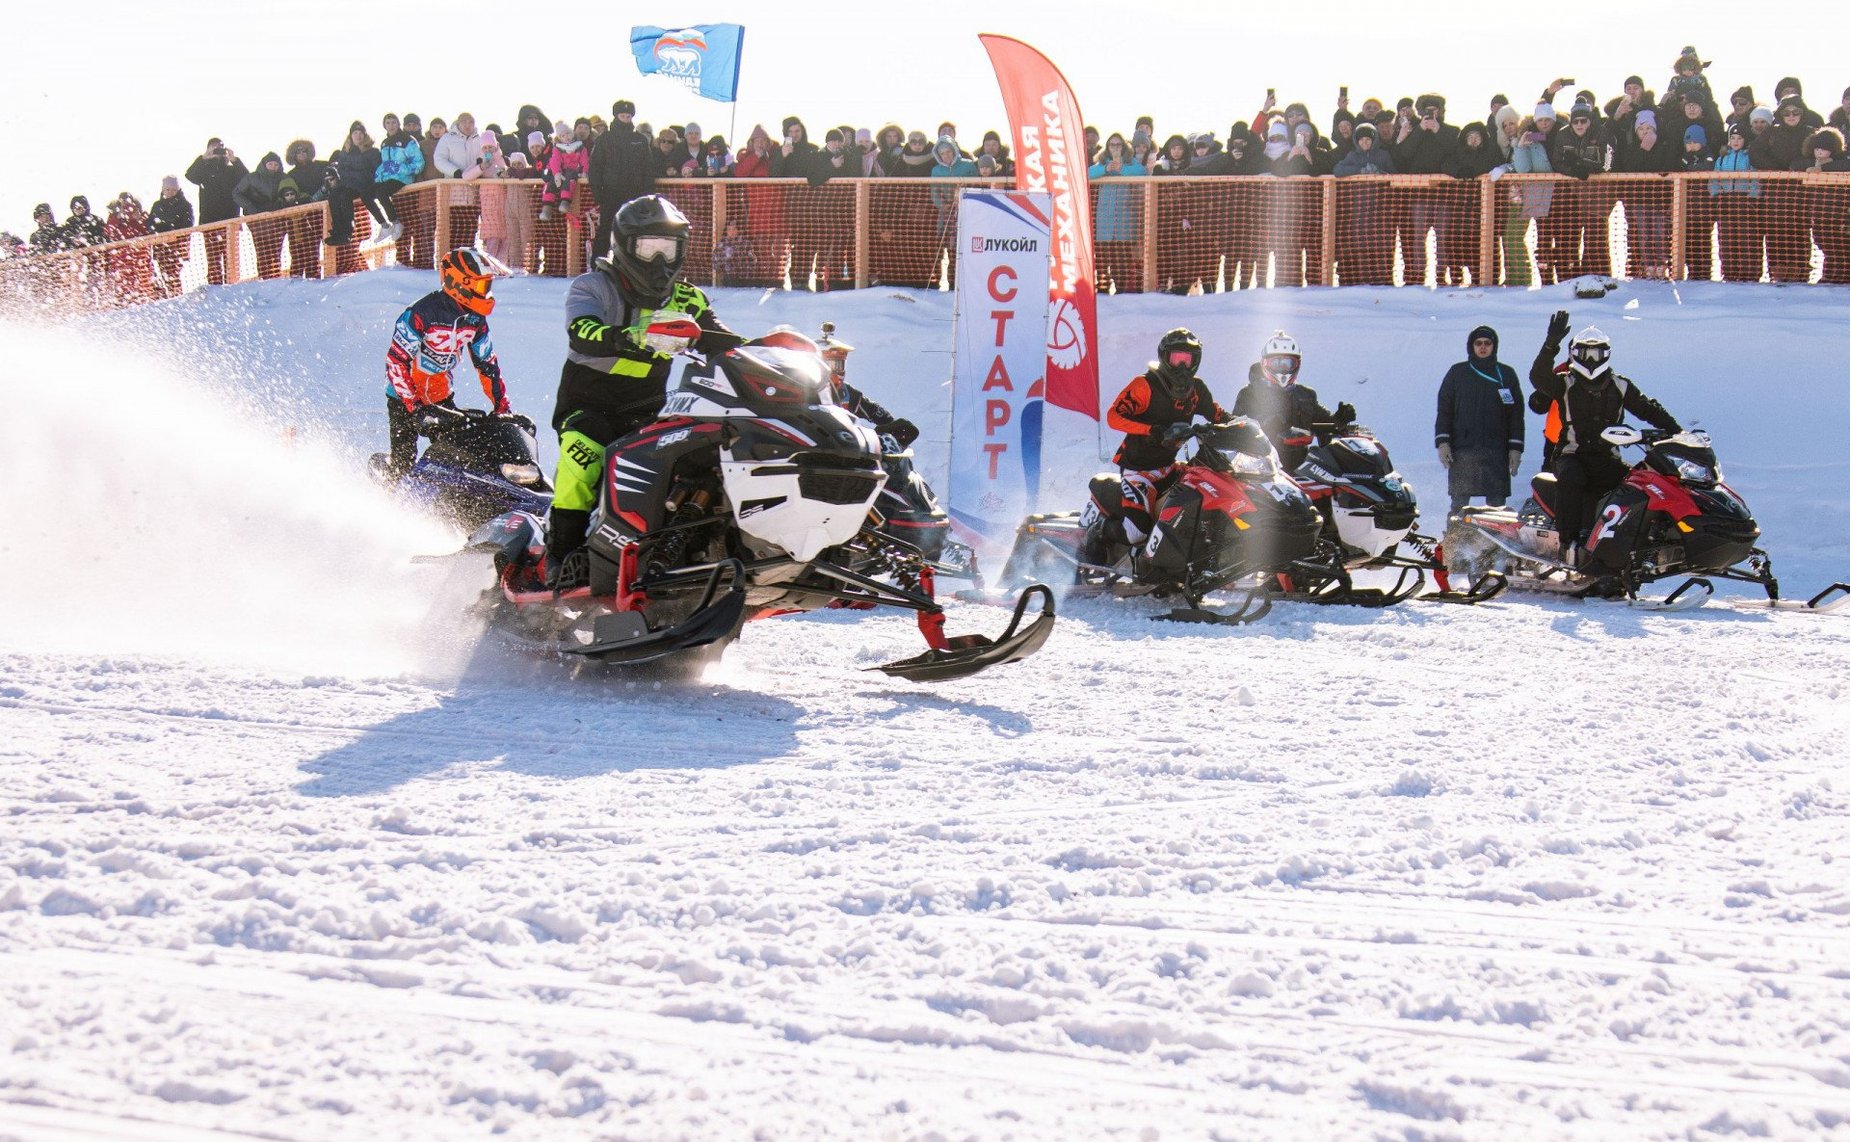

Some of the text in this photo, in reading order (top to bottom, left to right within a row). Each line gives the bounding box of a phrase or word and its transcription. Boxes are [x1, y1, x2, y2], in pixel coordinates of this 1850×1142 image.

[1021, 125, 1048, 192] КАЯ
[1041, 89, 1077, 293] МЕХАНИКА
[984, 236, 1037, 252] ЛУКОЙЛ
[566, 443, 597, 471] FOX
[1597, 503, 1622, 540] 2
